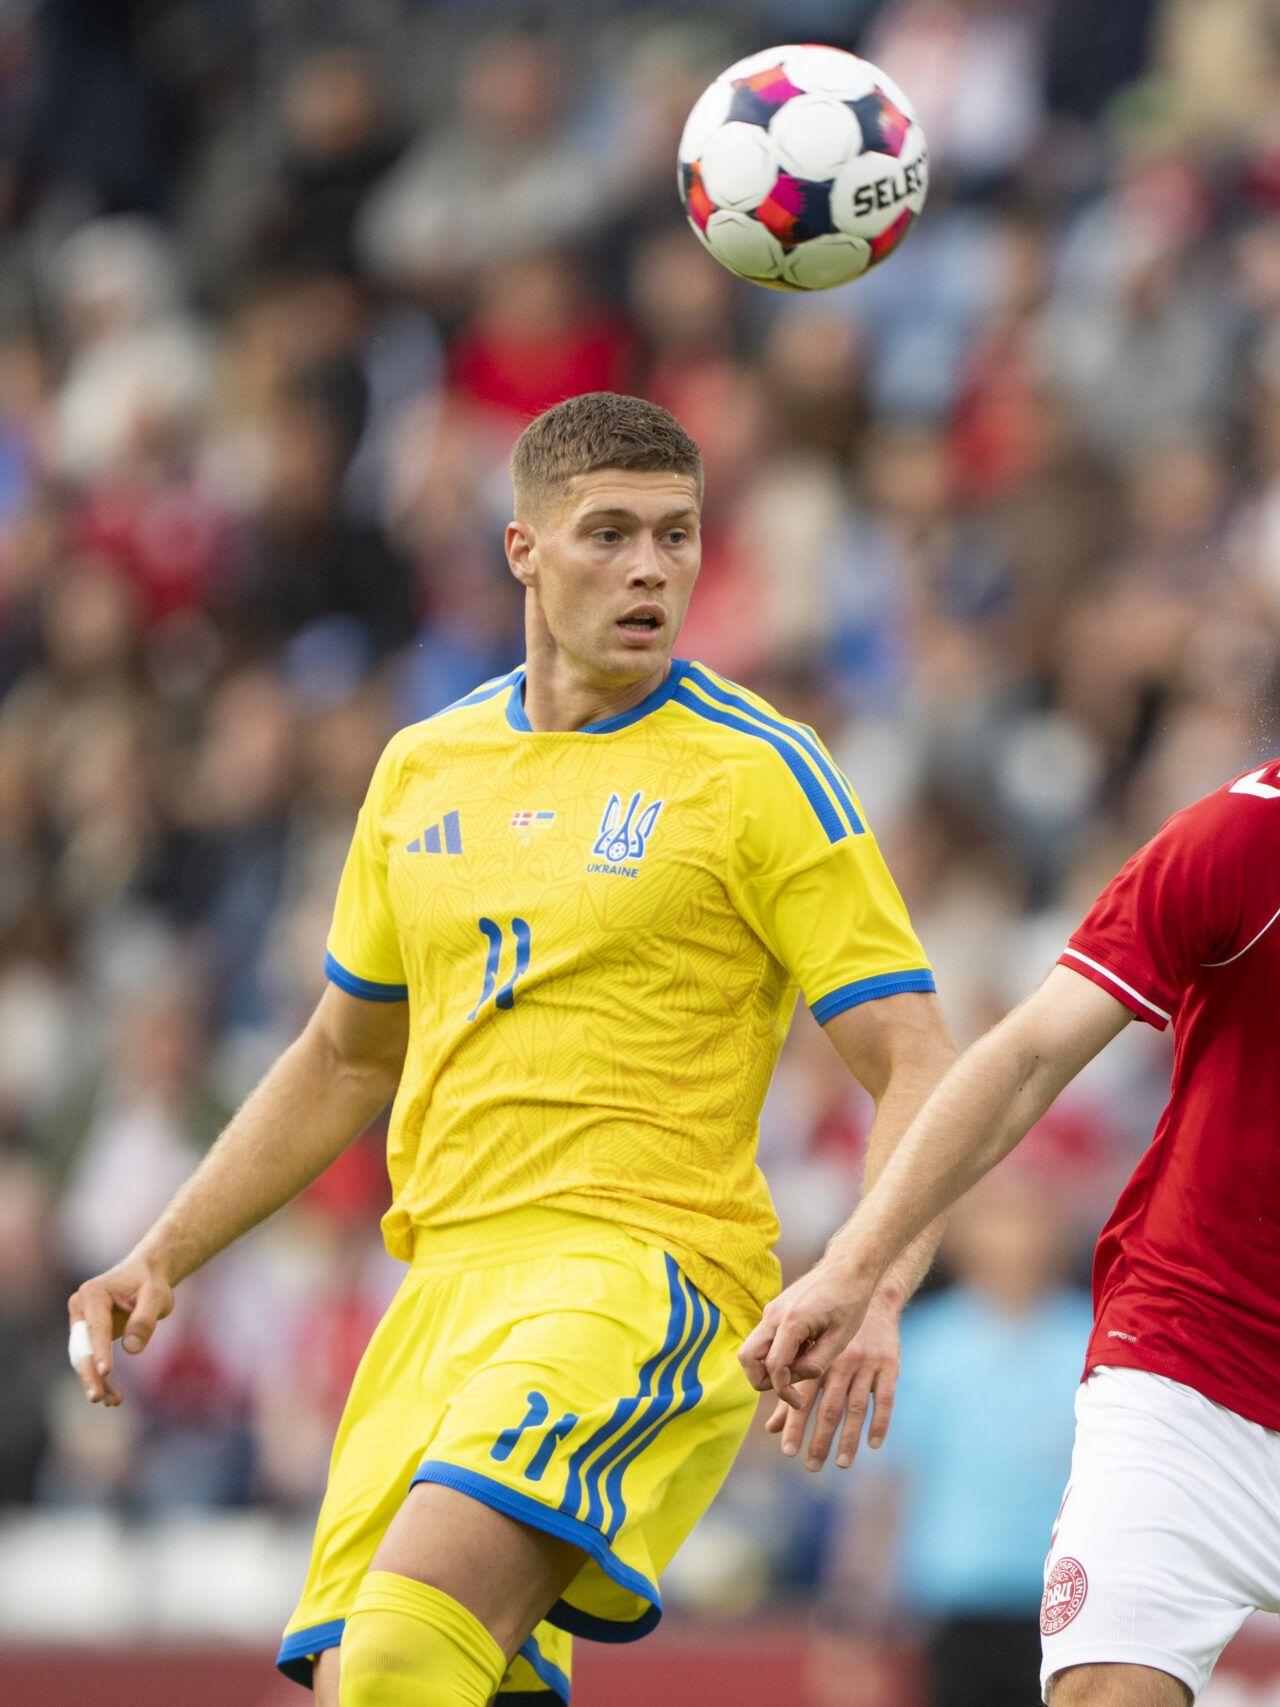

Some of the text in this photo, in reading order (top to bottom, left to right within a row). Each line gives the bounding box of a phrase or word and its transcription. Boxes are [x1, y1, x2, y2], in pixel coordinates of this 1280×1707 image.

[854, 151, 928, 218] SELEC
[586, 863, 639, 878] UKRAINE
[467, 917, 531, 1021] 11
